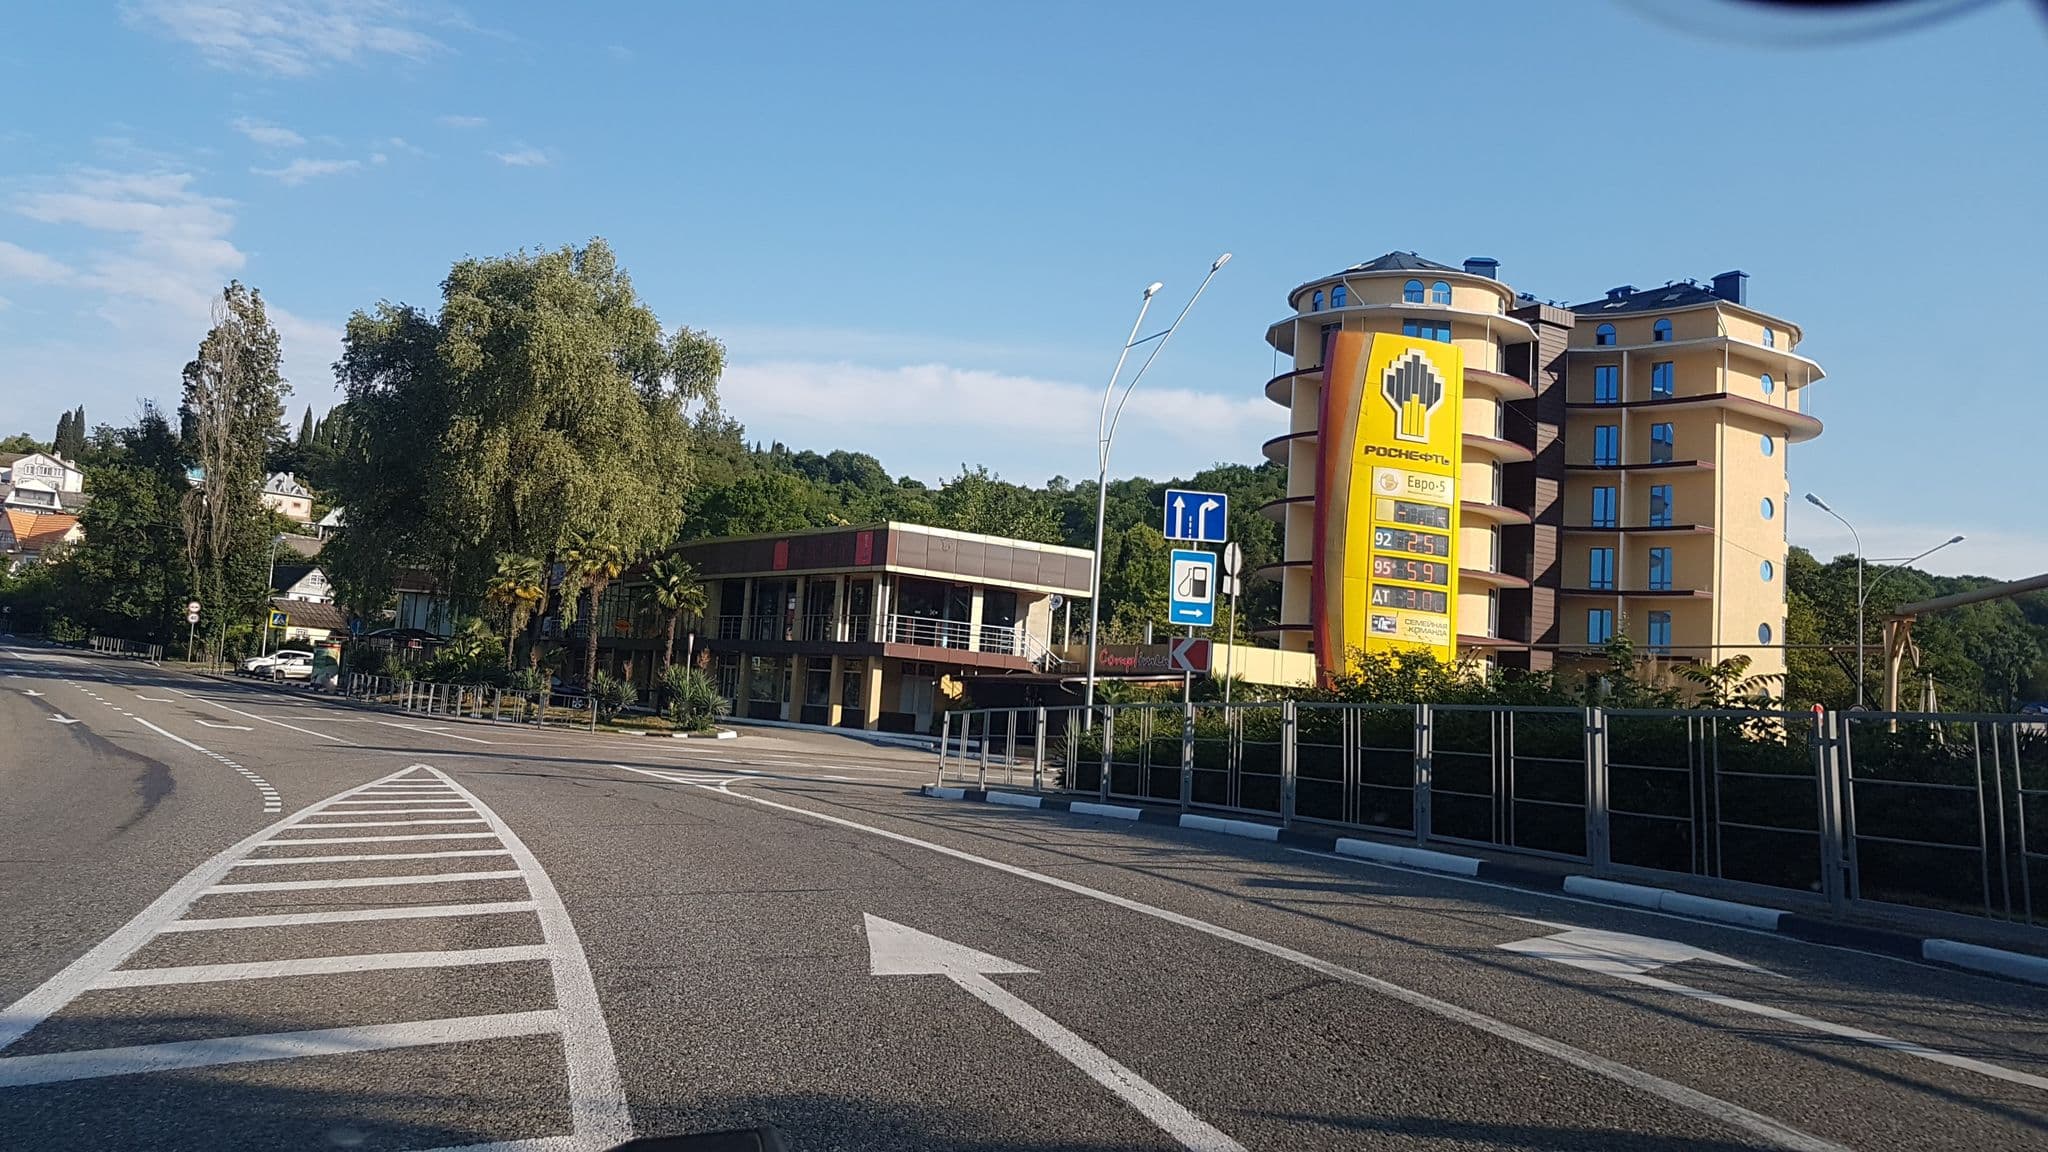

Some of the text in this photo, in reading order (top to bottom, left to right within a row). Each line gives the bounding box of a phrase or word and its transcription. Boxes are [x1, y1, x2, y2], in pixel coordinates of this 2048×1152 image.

[1364, 445, 1450, 465] РОСНЕФТЬ
[1375, 532, 1392, 546] 92
[1374, 560, 1391, 575] 95
[1372, 589, 1391, 605] ДТ
[1100, 646, 1169, 673] Complimen
